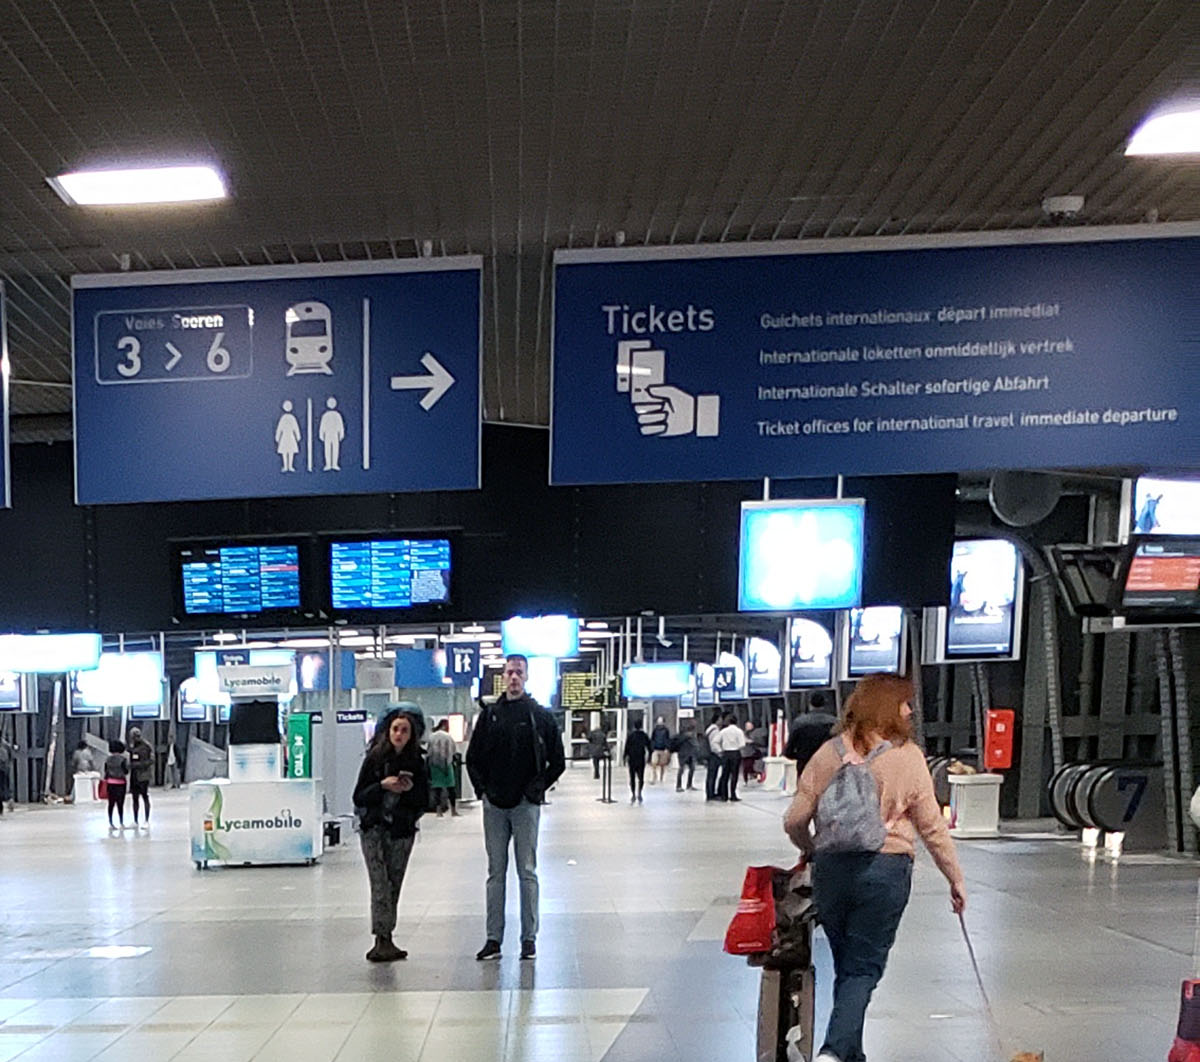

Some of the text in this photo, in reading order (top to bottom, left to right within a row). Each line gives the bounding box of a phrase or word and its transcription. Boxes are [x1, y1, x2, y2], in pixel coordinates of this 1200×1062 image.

[601, 304, 715, 334] Tickets
[760, 312, 823, 329] Guichets
[826, 308, 929, 326] internationaux
[117, 336, 141, 377] 3
[207, 332, 230, 373] 6
[759, 348, 859, 365] Internationale
[862, 345, 922, 361] loketten
[1019, 336, 1074, 354] vertrek
[758, 375, 1050, 400] Internationale Schalter sofortige Abfahrt
[757, 408, 1178, 436] Ticket offices for international travel immediate departure
[223, 672, 282, 689] Lycamobile
[1117, 775, 1149, 824] 7
[216, 815, 303, 833] Lycamobile
